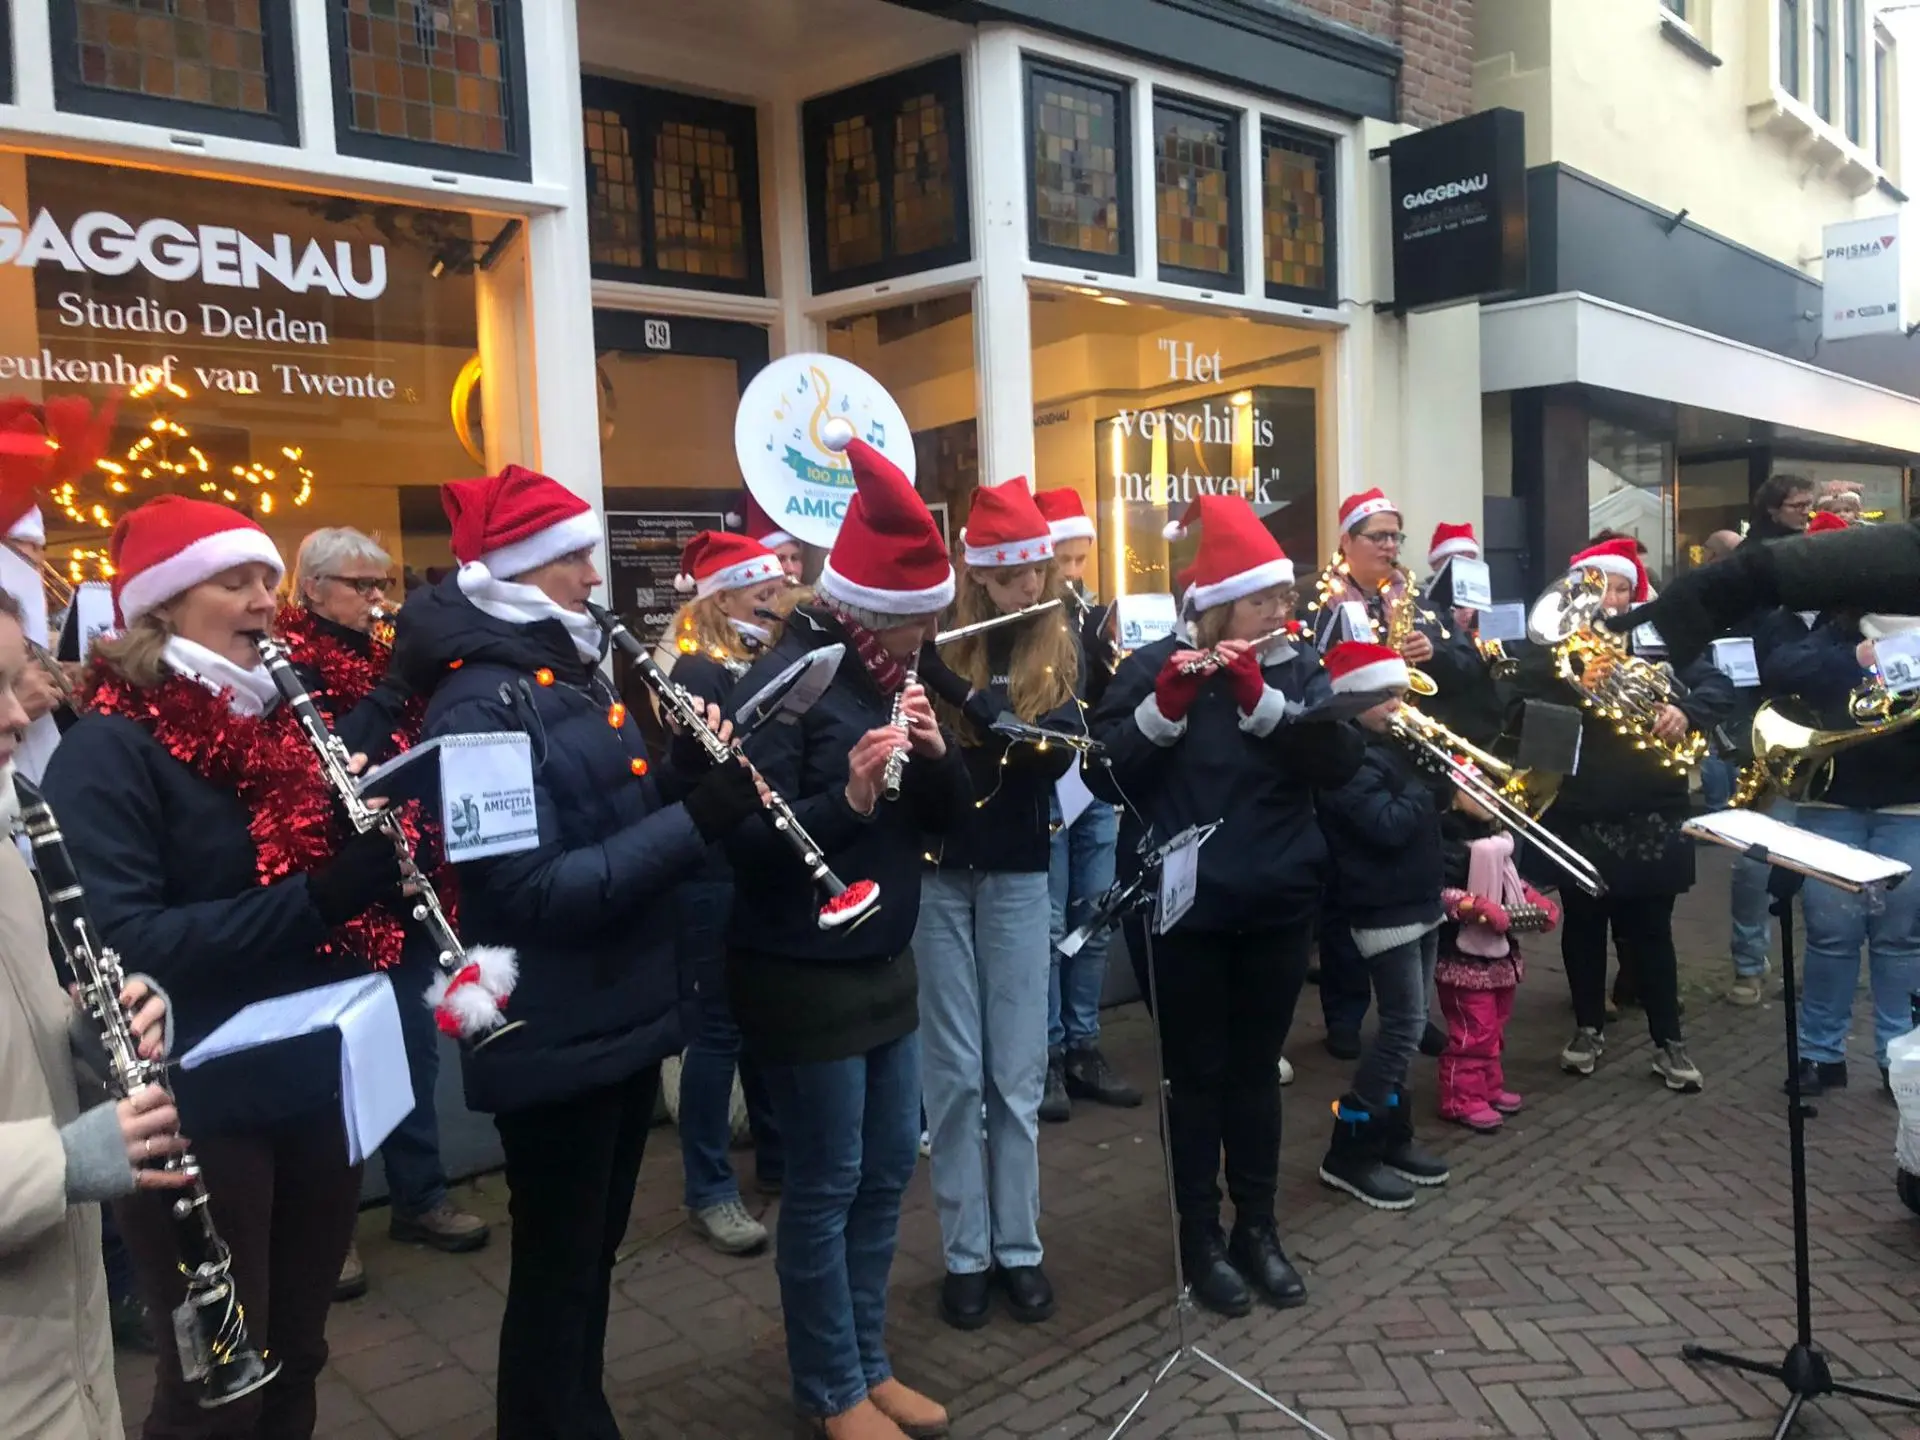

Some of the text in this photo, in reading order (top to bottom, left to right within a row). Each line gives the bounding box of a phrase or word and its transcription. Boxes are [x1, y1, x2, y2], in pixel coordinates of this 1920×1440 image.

[1403, 173, 1488, 209] GAGGENAU
[1826, 240, 1881, 258] PRISMA
[57, 292, 329, 344] Studio Delden
[648, 322, 667, 347] 39
[0, 349, 396, 398] eukenhof van Twente
[1157, 337, 1224, 384] "Het
[1118, 403, 1275, 447] verschil is
[807, 465, 831, 483] 100
[784, 495, 848, 521] AMIC
[484, 796, 532, 813] AMICITIA
